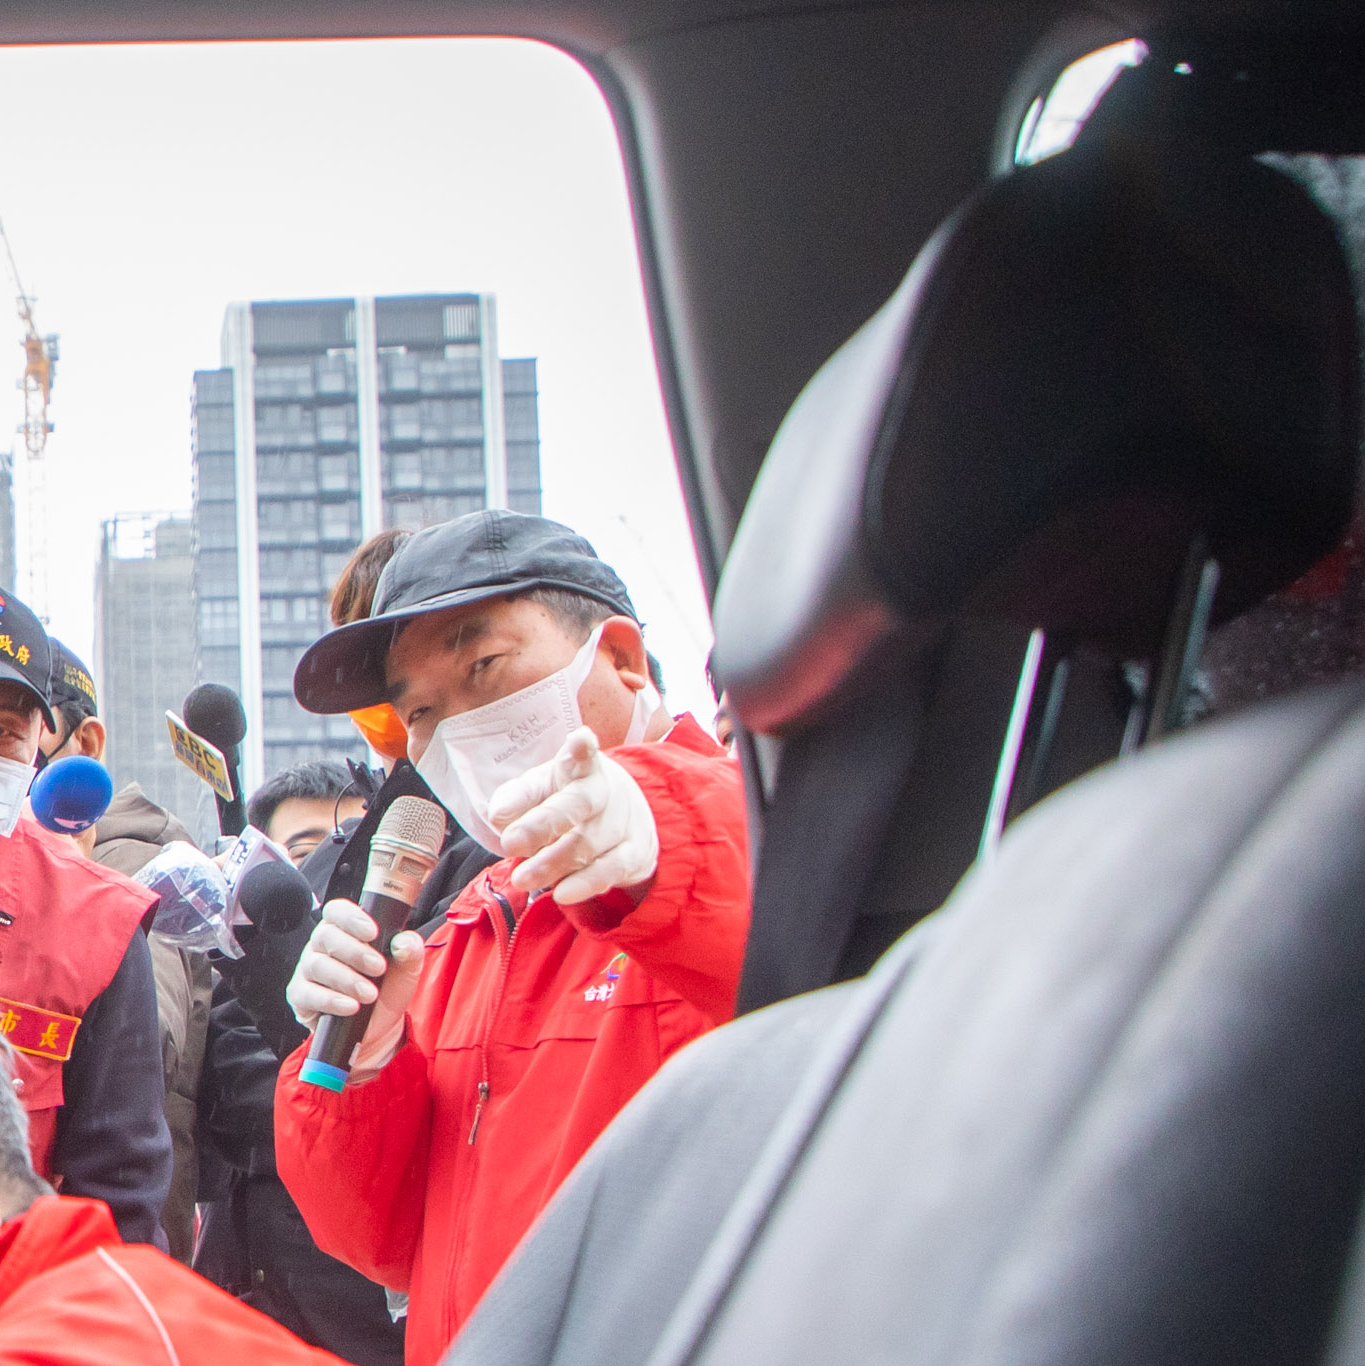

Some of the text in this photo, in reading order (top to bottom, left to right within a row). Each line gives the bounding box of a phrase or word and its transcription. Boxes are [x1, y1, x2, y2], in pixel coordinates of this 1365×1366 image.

[493, 745, 518, 764] Made
[526, 715, 558, 739] Taiwan
[508, 713, 540, 742] KNH
